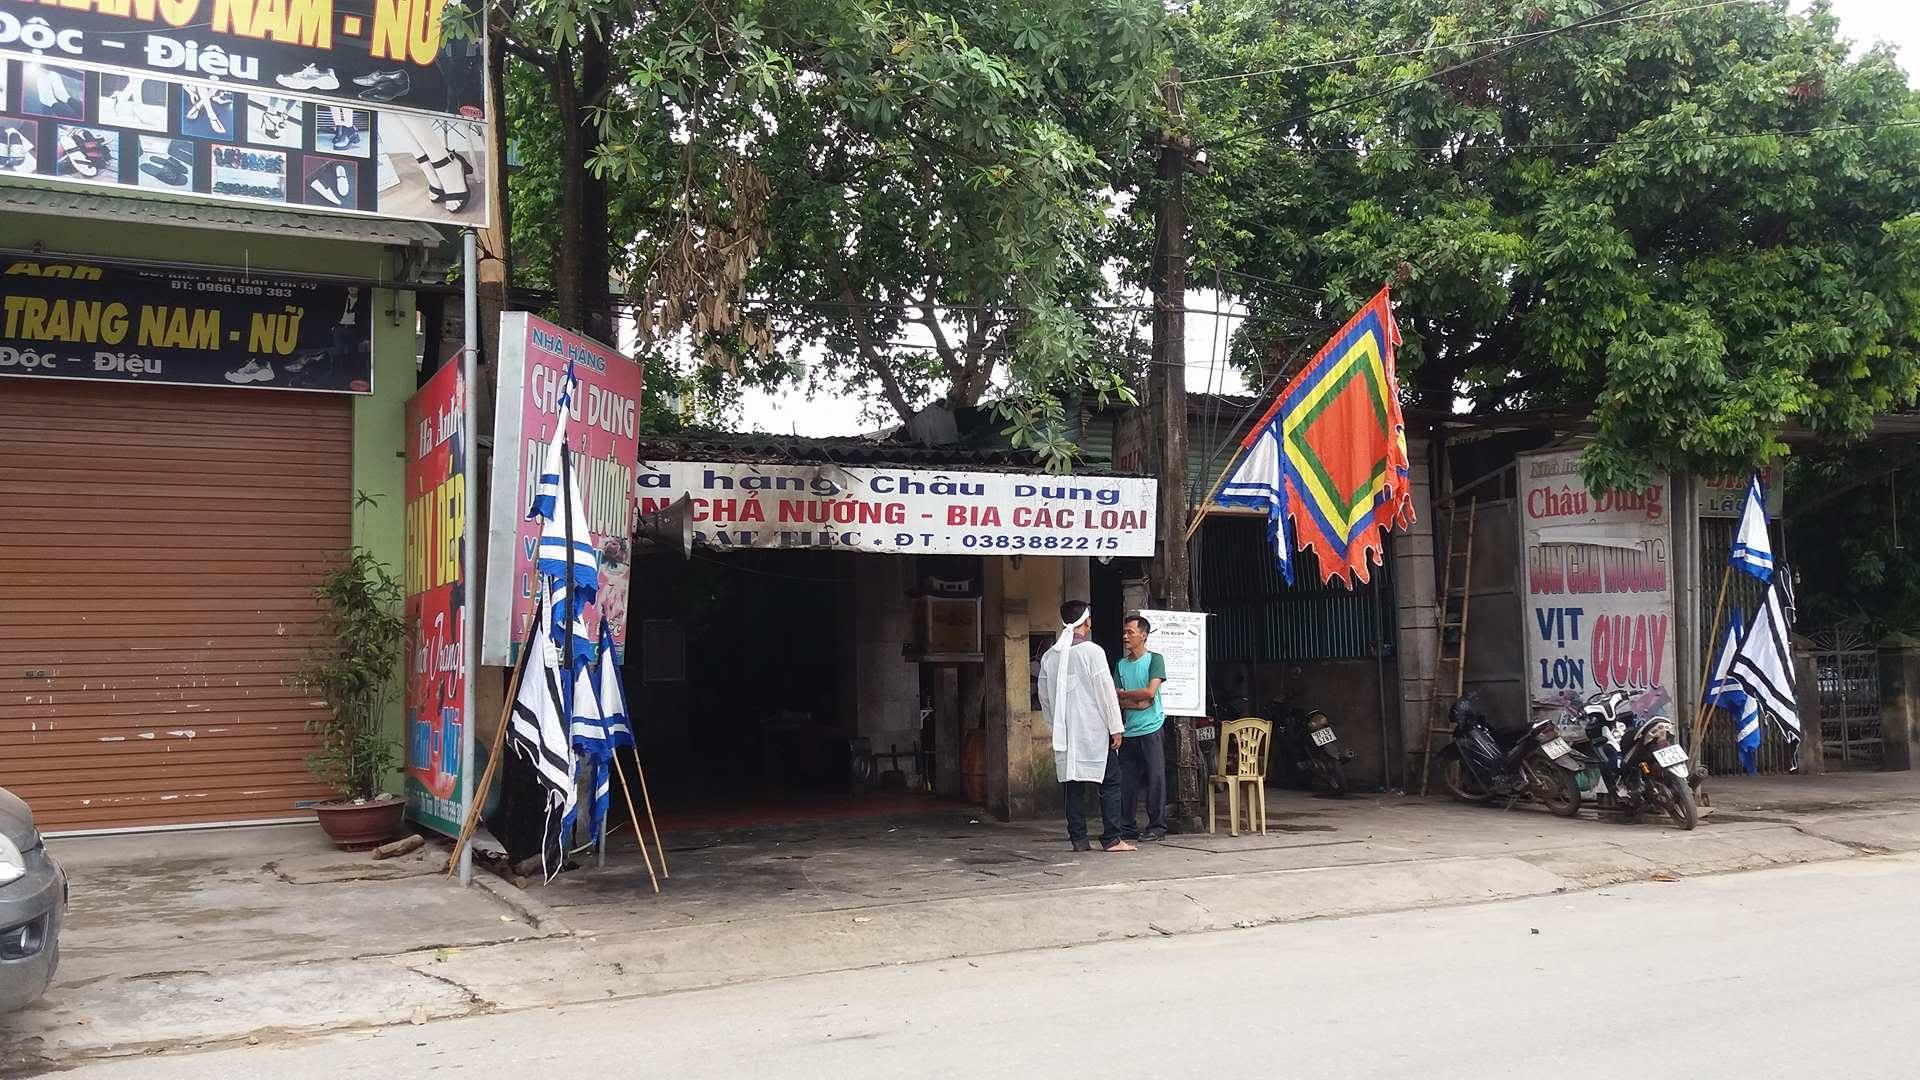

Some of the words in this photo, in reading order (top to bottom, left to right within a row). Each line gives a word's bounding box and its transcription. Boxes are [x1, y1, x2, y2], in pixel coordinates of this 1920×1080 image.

[144, 34, 259, 81] Điệu
[4, 295, 129, 345] TRANG
[137, 305, 221, 350] NAM
[249, 305, 304, 355] NỮ
[93, 351, 162, 377] Điệu
[532, 327, 564, 355] NHÀ
[568, 342, 606, 372] HÀNG
[587, 383, 635, 440] DUNG
[703, 466, 842, 497] hàng
[869, 474, 985, 497] Châu
[1014, 484, 1121, 505] Dung
[1527, 484, 1588, 519] Châu
[691, 490, 766, 523] CHẢ
[778, 493, 906, 525] NƯỚNG
[946, 505, 1001, 527] BIA
[1013, 502, 1075, 529] CÁC
[1084, 509, 1147, 534] LOẠI
[1536, 607, 1584, 648] VỊT
[1591, 613, 1667, 692] QUAY
[1540, 655, 1584, 696] LỢN
